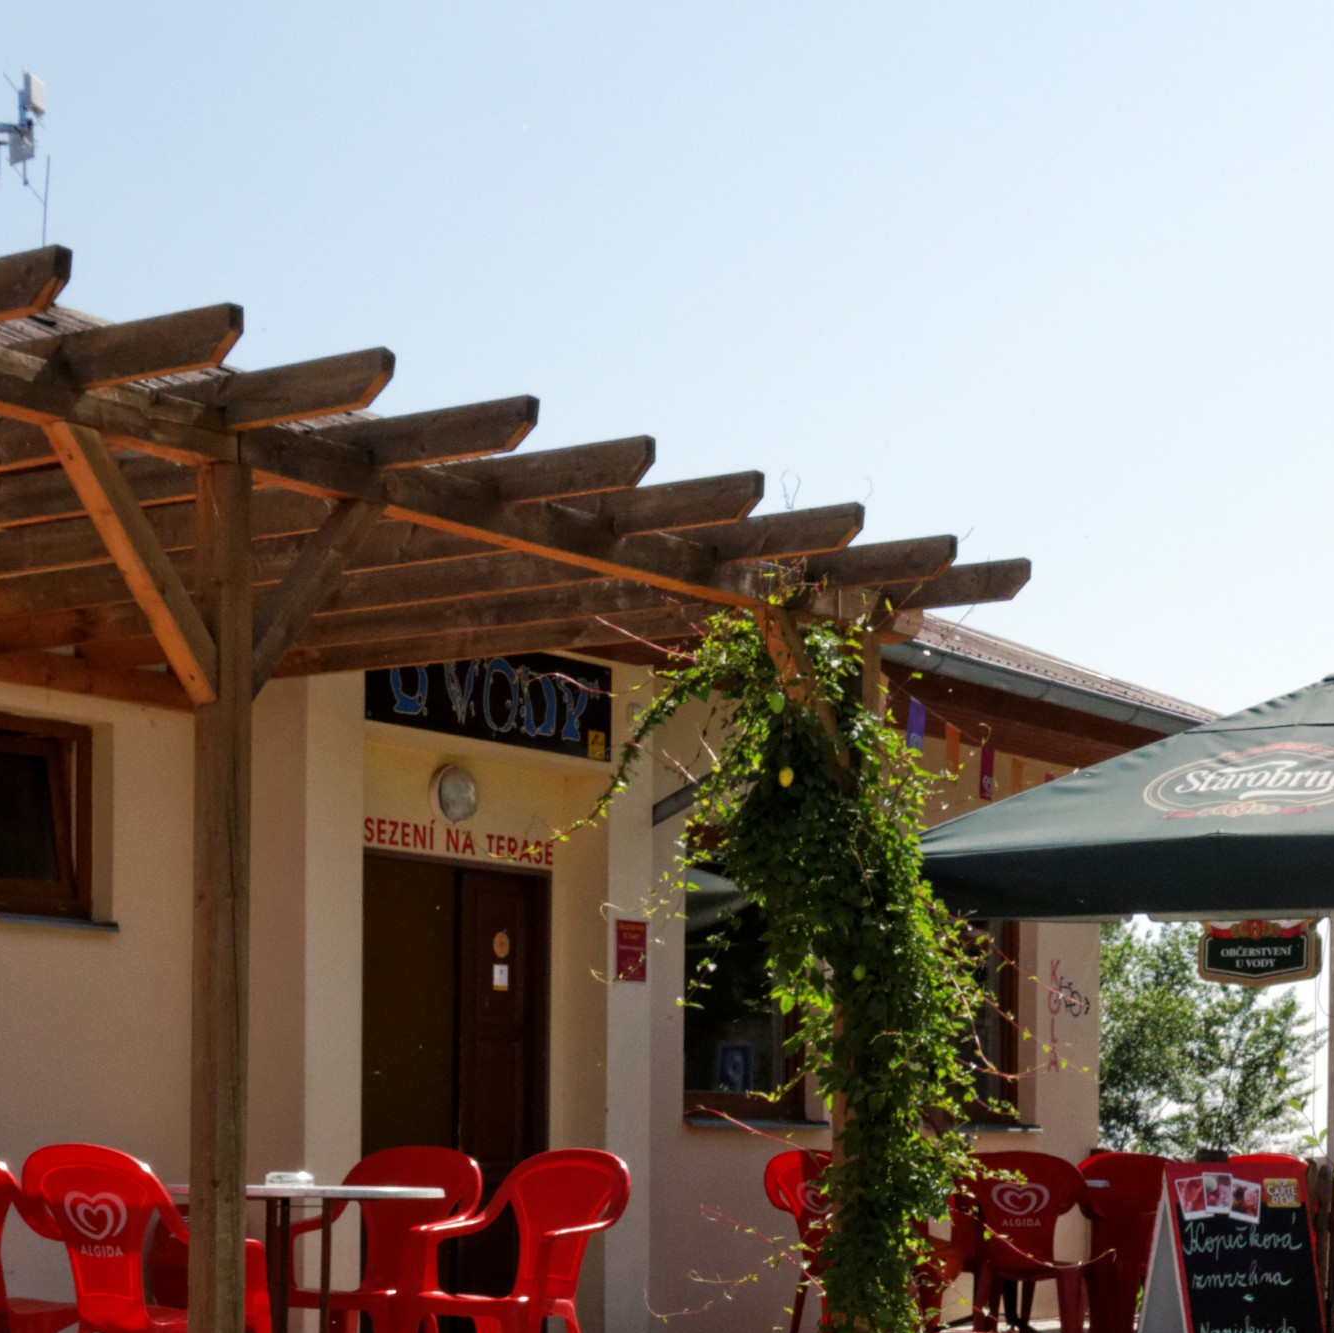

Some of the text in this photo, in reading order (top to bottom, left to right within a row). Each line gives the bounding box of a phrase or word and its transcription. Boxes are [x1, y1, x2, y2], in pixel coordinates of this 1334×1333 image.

[363, 816, 555, 866] SEZENÍ NA TERASE
[1220, 943, 1293, 958] OBČERSTVENÍ
[1235, 957, 1277, 968] U VODY
[1266, 1184, 1299, 1197] CARTE
[1001, 1217, 1043, 1228] ALGIDA
[80, 1243, 125, 1259] ALGIDA
